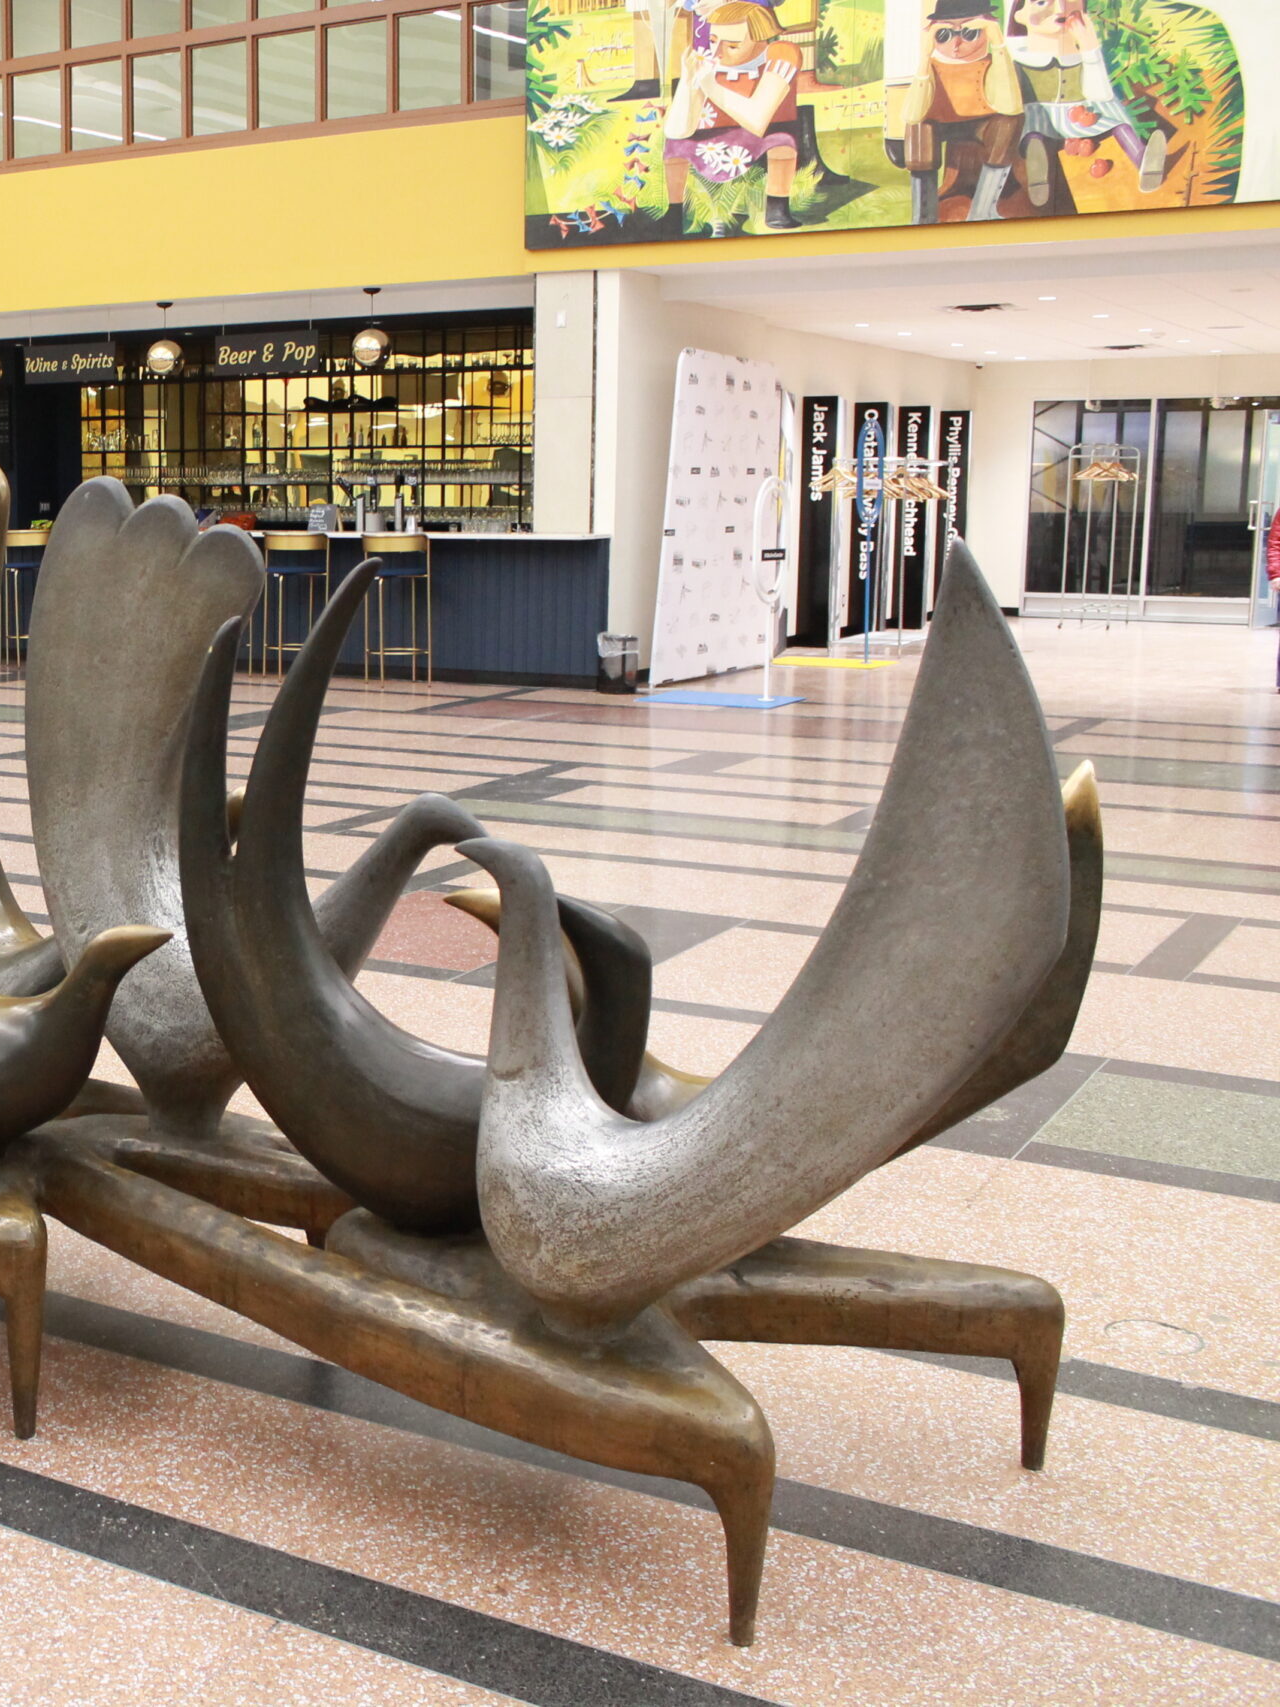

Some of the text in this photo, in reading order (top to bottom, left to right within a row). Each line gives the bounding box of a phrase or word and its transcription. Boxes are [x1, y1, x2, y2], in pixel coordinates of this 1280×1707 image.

[25, 357, 58, 374] Wine
[71, 353, 114, 375] Spirits
[218, 341, 316, 367] Beer & Pop
[812, 403, 829, 444] Jack
[945, 416, 962, 465] Phyllis
